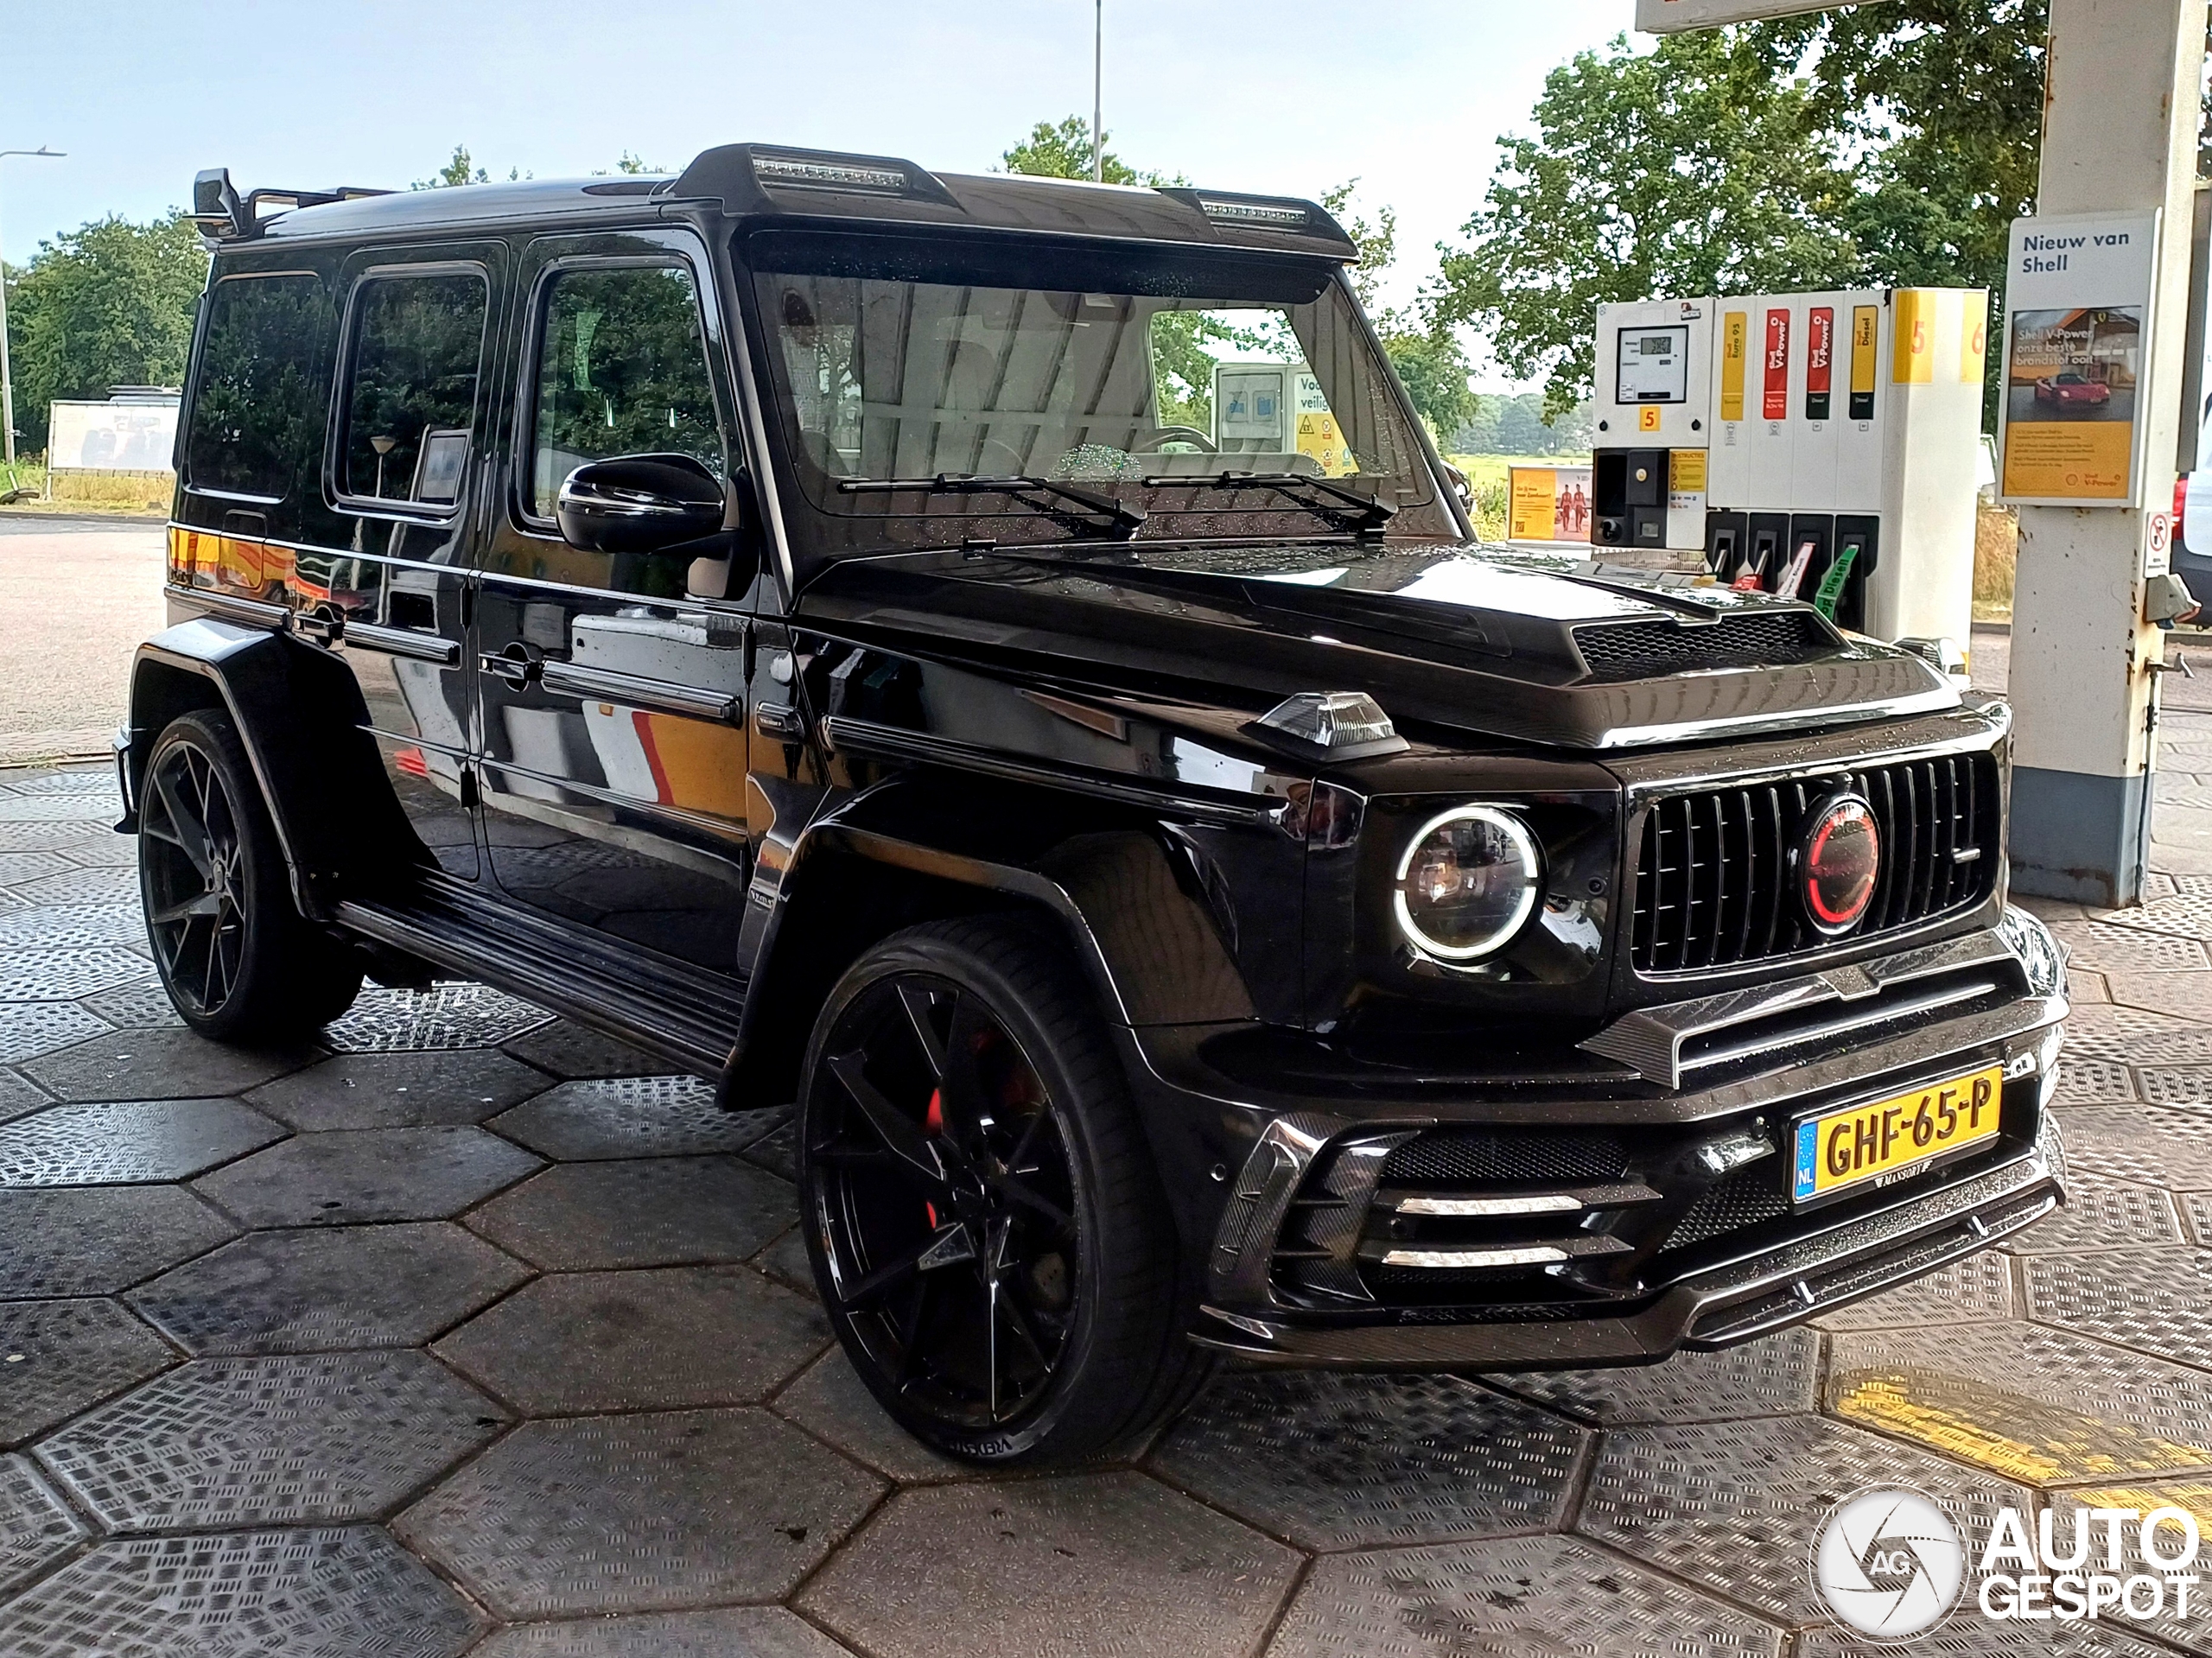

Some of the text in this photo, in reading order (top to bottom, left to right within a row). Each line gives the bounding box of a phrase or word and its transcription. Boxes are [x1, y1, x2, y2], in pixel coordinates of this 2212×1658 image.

[2024, 233, 2129, 251] Nieuw van
[2023, 254, 2068, 272] Shell
[1732, 323, 1740, 335] 95
[1911, 321, 1924, 354] 5
[1972, 322, 1983, 354] 6
[2018, 328, 2094, 340] Shell V-Power
[1775, 321, 1786, 369] V-Power
[1819, 320, 1829, 368] V-Power
[2017, 340, 2076, 353] onze beste
[2016, 353, 2069, 365] brandstof
[1645, 411, 1655, 427] 5
[1827, 1077, 1992, 1177] GHF-65-P
[1798, 1170, 1814, 1185] NL
